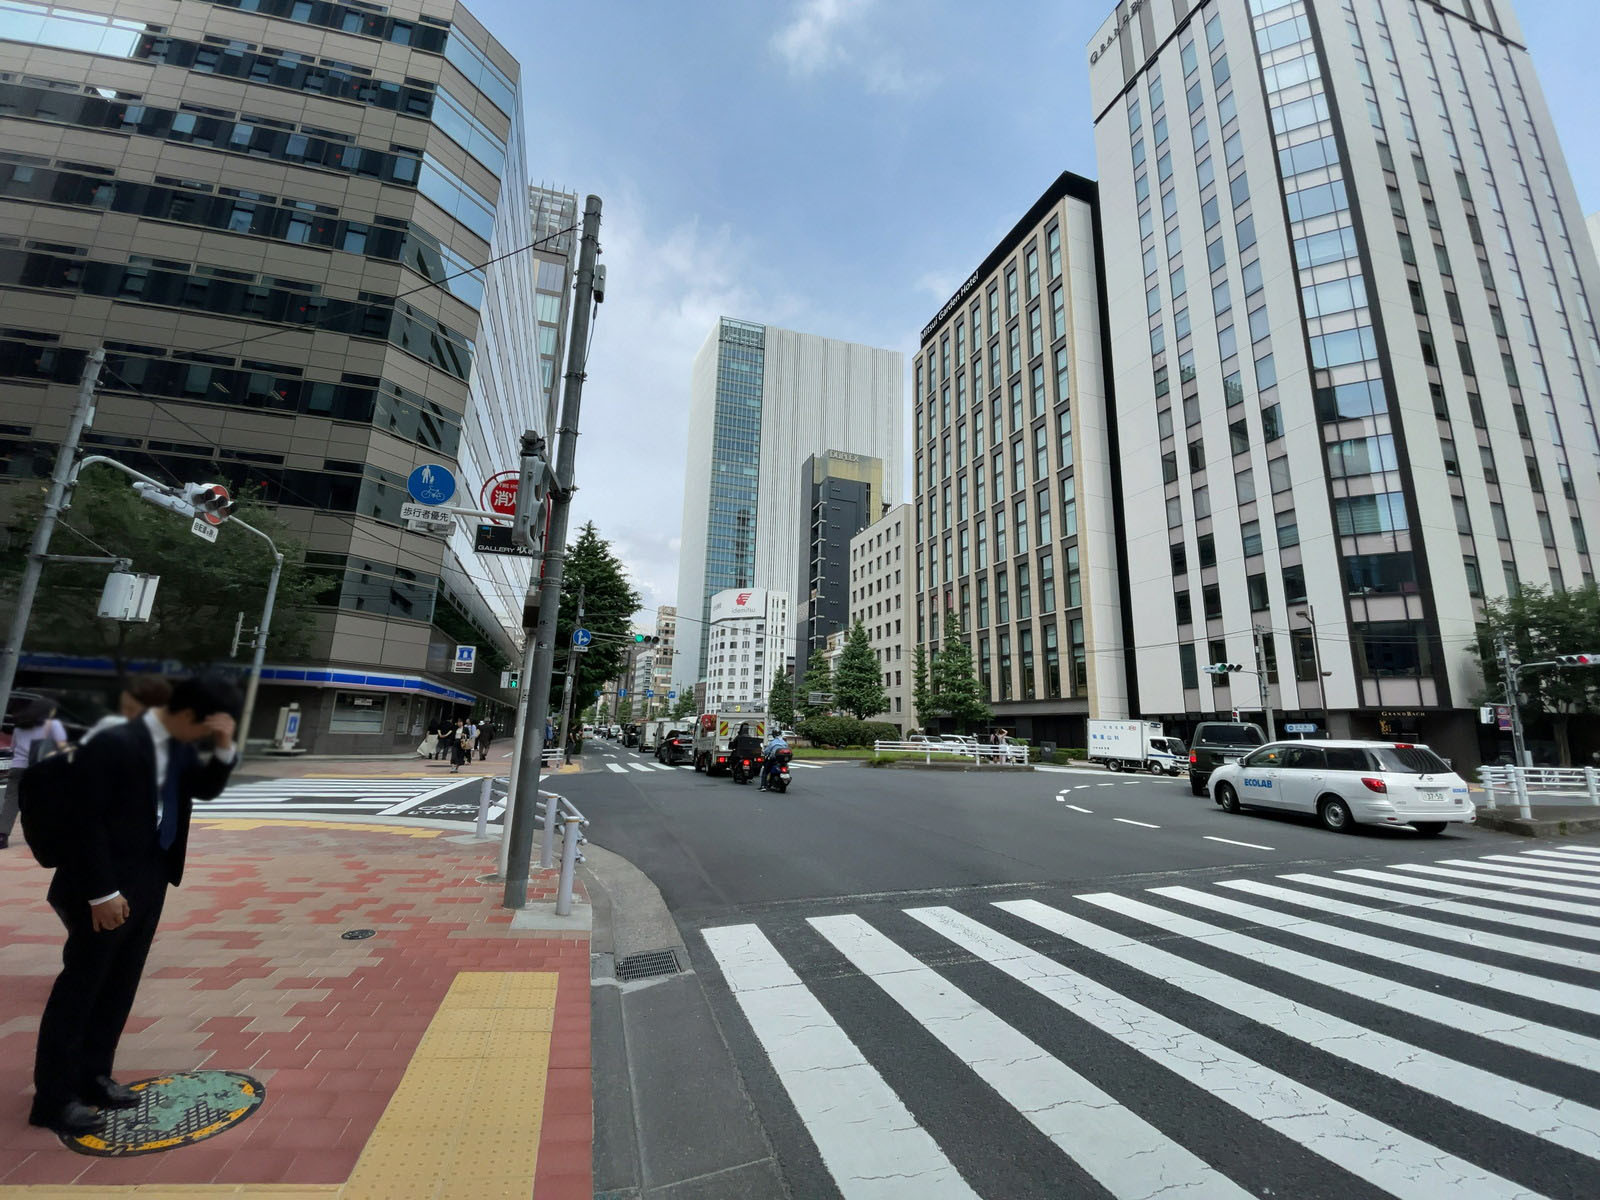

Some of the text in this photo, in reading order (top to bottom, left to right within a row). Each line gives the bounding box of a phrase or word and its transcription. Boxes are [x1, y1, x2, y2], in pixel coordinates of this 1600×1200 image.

[920, 270, 979, 340] Mitsui Garden Hotel
[494, 490, 517, 506] 消火
[403, 506, 449, 522] 歩行者優先
[477, 544, 516, 554] GALLERY
[731, 606, 756, 614] idemitsu
[1244, 778, 1273, 788] ECOLAB
